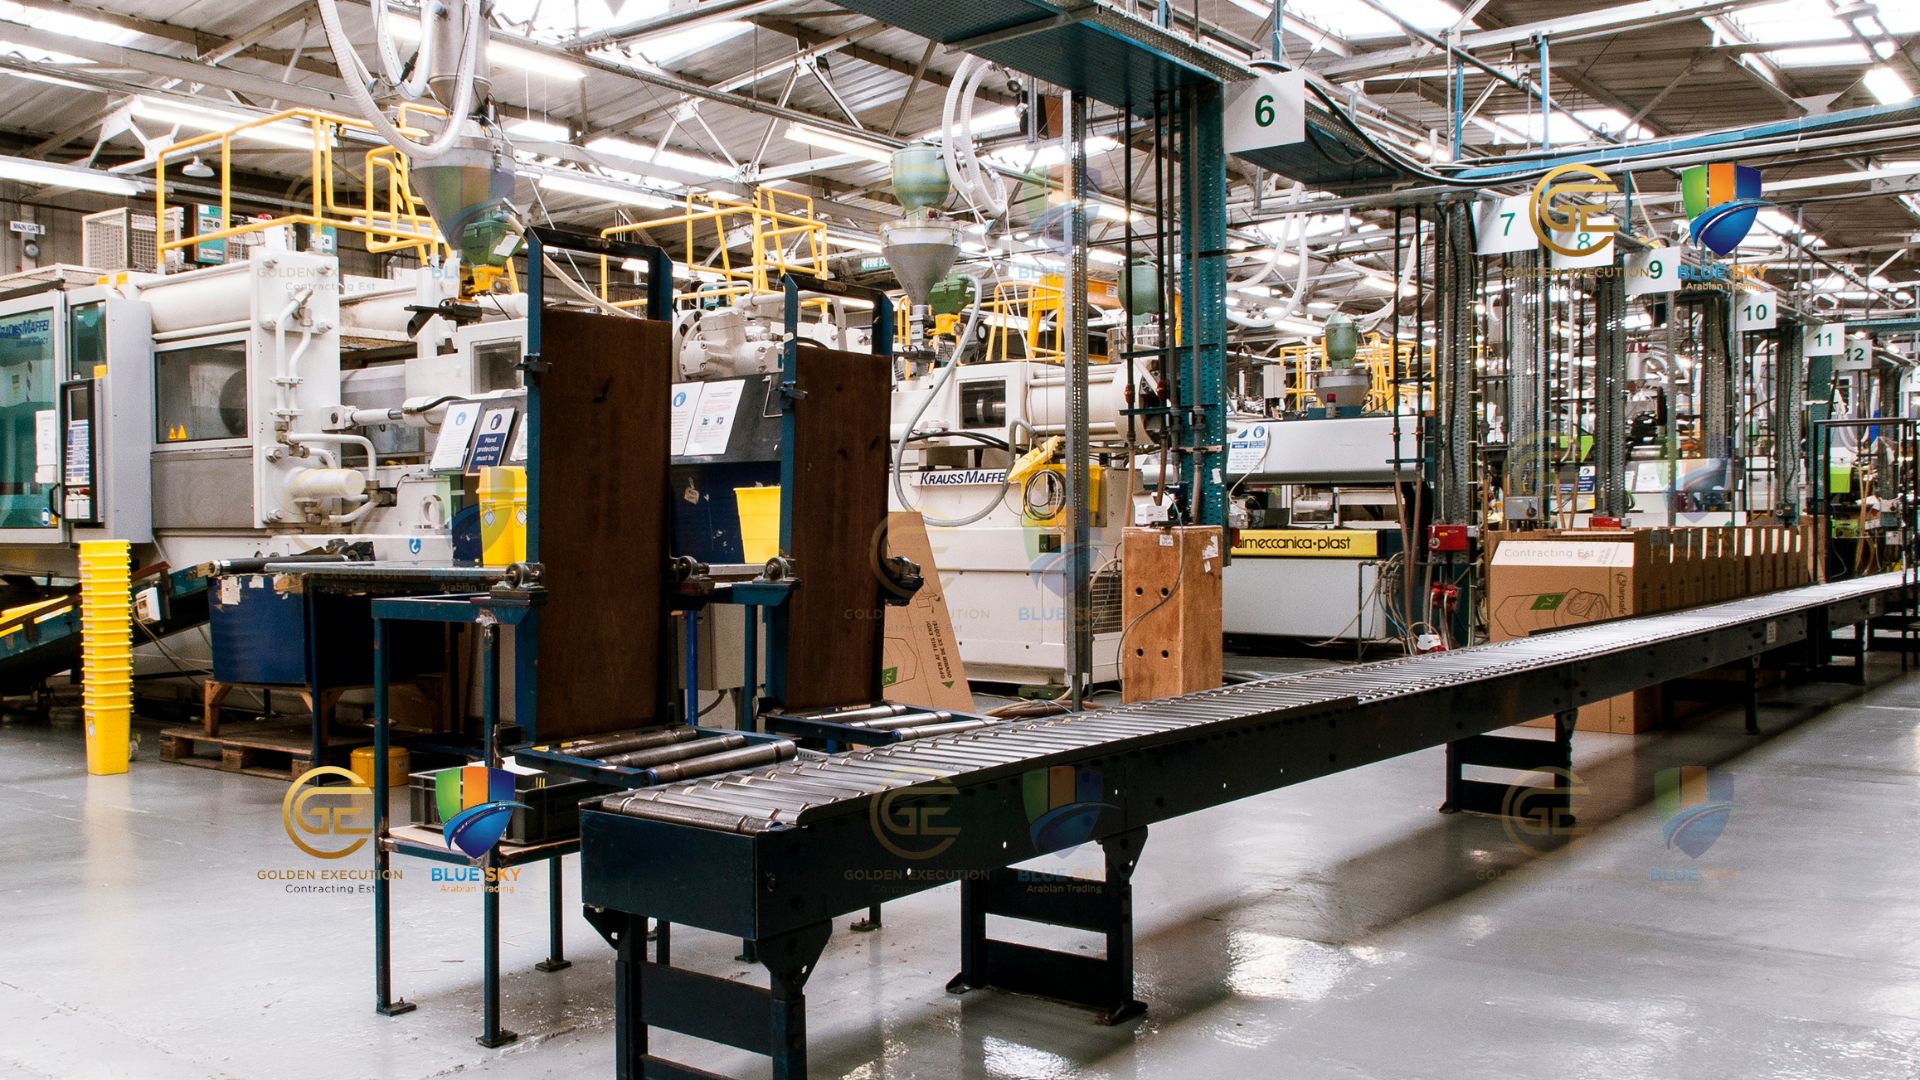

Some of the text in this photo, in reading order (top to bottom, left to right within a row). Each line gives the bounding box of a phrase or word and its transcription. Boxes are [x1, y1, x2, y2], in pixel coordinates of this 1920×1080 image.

[1254, 95, 1275, 127] 6
[1500, 212, 1516, 237] 7
[1577, 232, 1591, 250] 8
[1649, 260, 1663, 280] 9
[1743, 304, 1768, 321] 10
[1814, 333, 1832, 347] 11
[1844, 348, 1865, 361] 12
[936, 662, 946, 680] OPEN
